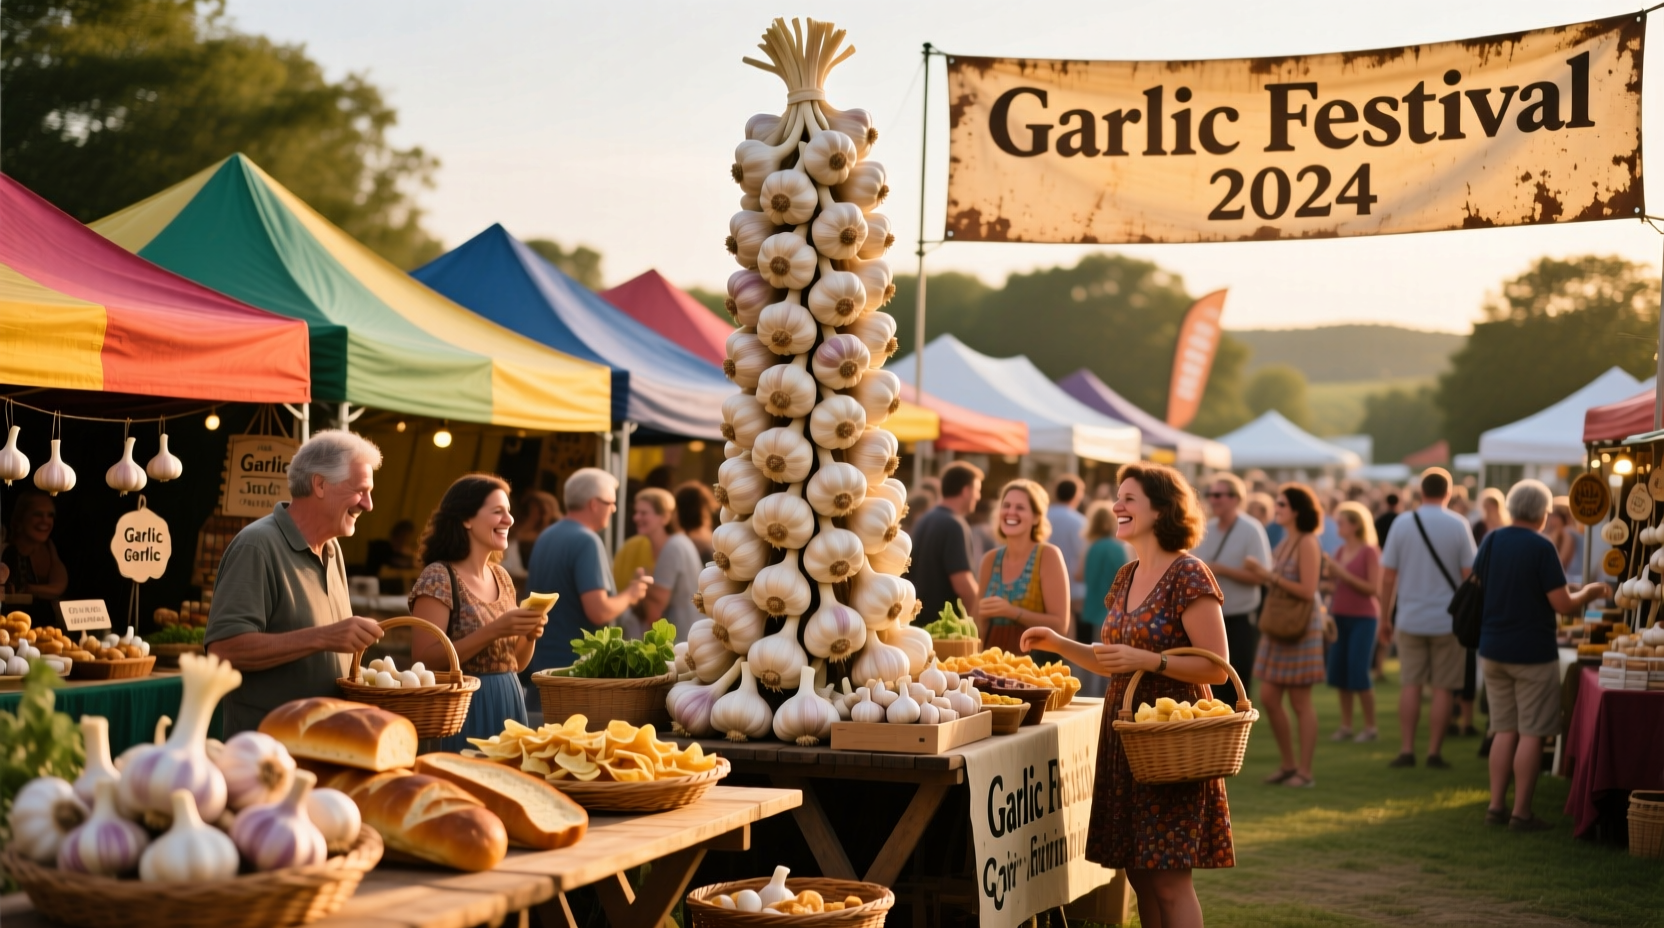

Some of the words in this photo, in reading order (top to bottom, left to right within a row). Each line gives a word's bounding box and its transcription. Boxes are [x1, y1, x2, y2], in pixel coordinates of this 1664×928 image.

[988, 85, 1240, 158] Garlic
[1263, 51, 1596, 153] Festival
[1207, 163, 1378, 221] 2024
[240, 453, 290, 474] Garlic
[124, 527, 163, 543] Garlic
[987, 765, 1043, 838] Garlic
